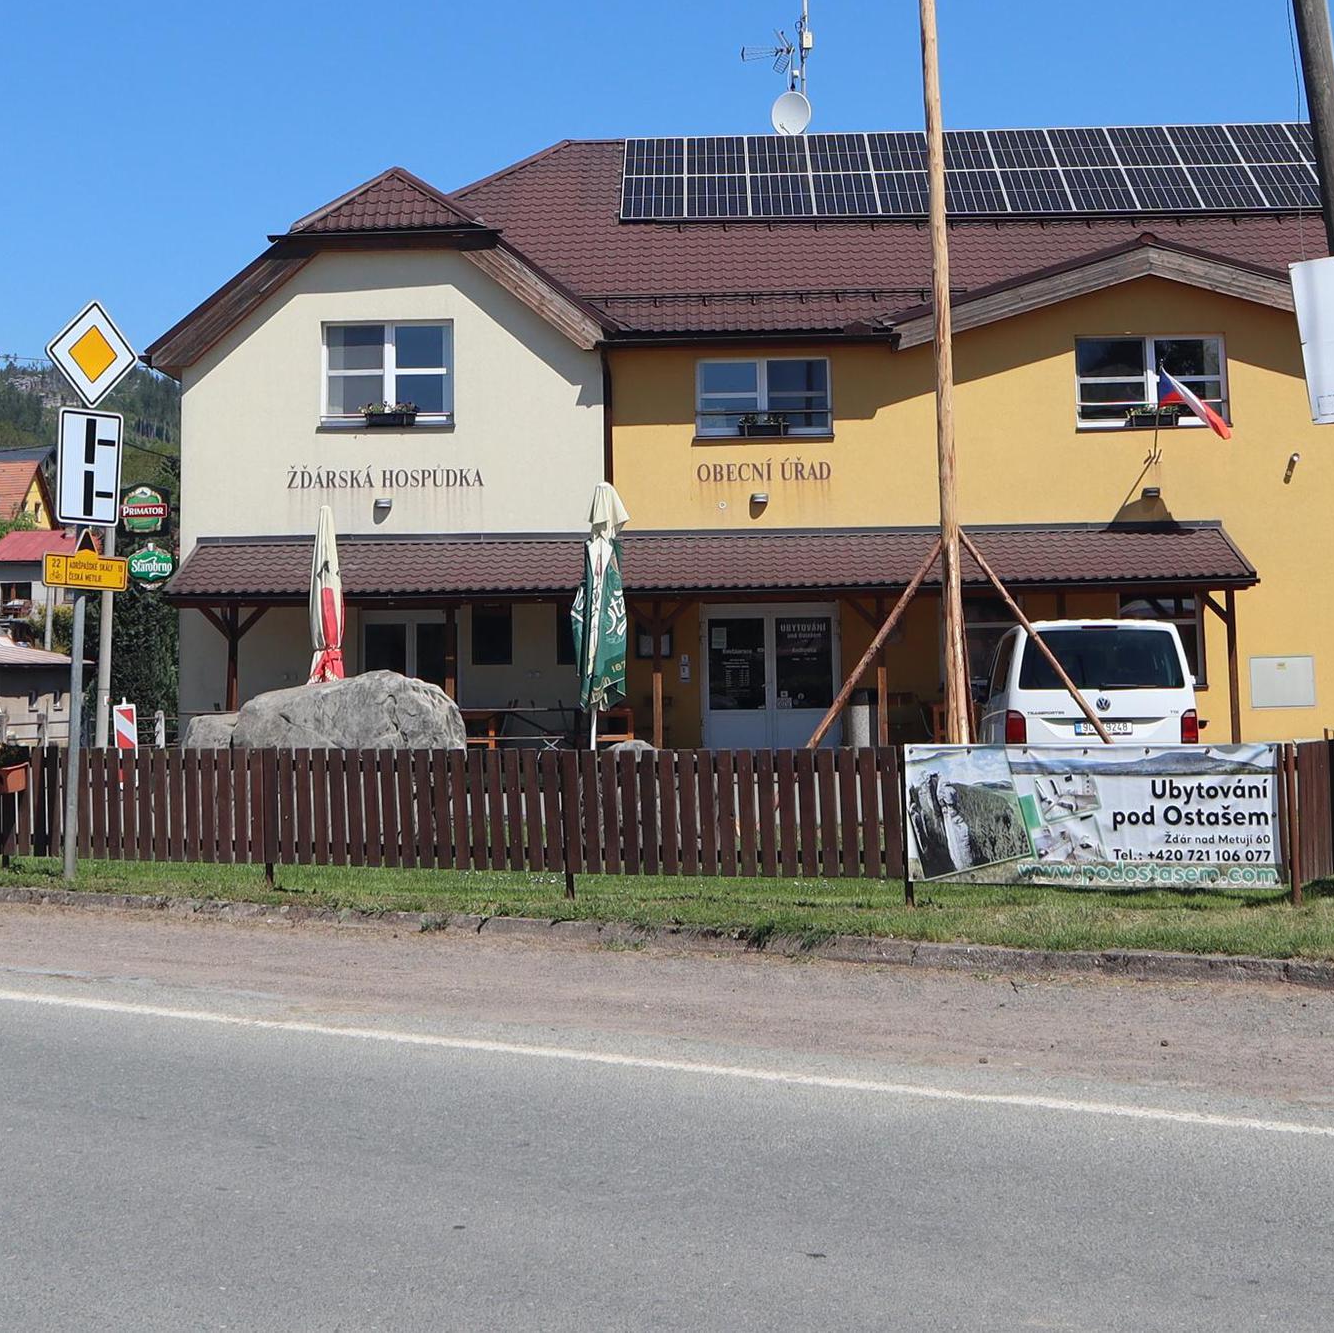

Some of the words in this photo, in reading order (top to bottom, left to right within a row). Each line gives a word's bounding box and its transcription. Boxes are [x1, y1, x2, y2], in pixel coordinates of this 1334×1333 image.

[286, 465, 375, 489] ŽĎÁRSKÁ
[381, 463, 485, 488] HOSPŮDKA
[696, 457, 772, 482] OBECNÍ
[781, 456, 831, 481] ÚŘAD
[122, 506, 164, 517] PRIMATOR
[51, 559, 61, 568] 22
[131, 556, 173, 578] Starobrno
[1106, 722, 1128, 731] 9248
[1151, 778, 1268, 805] Ubytování
[1112, 805, 1155, 831] pod
[1163, 805, 1269, 826] Ostašem
[1165, 831, 1192, 844] Žďár
[1195, 834, 1215, 844] nad
[1218, 834, 1253, 846] Metují
[1256, 834, 1271, 844] 60
[1113, 848, 1143, 861] Tel.:
[1147, 850, 1183, 861] +420
[1187, 850, 1211, 861] 721
[1215, 850, 1240, 861] 106
[1245, 850, 1271, 861] 077
[1017, 860, 1279, 885] www.podostasem.com
